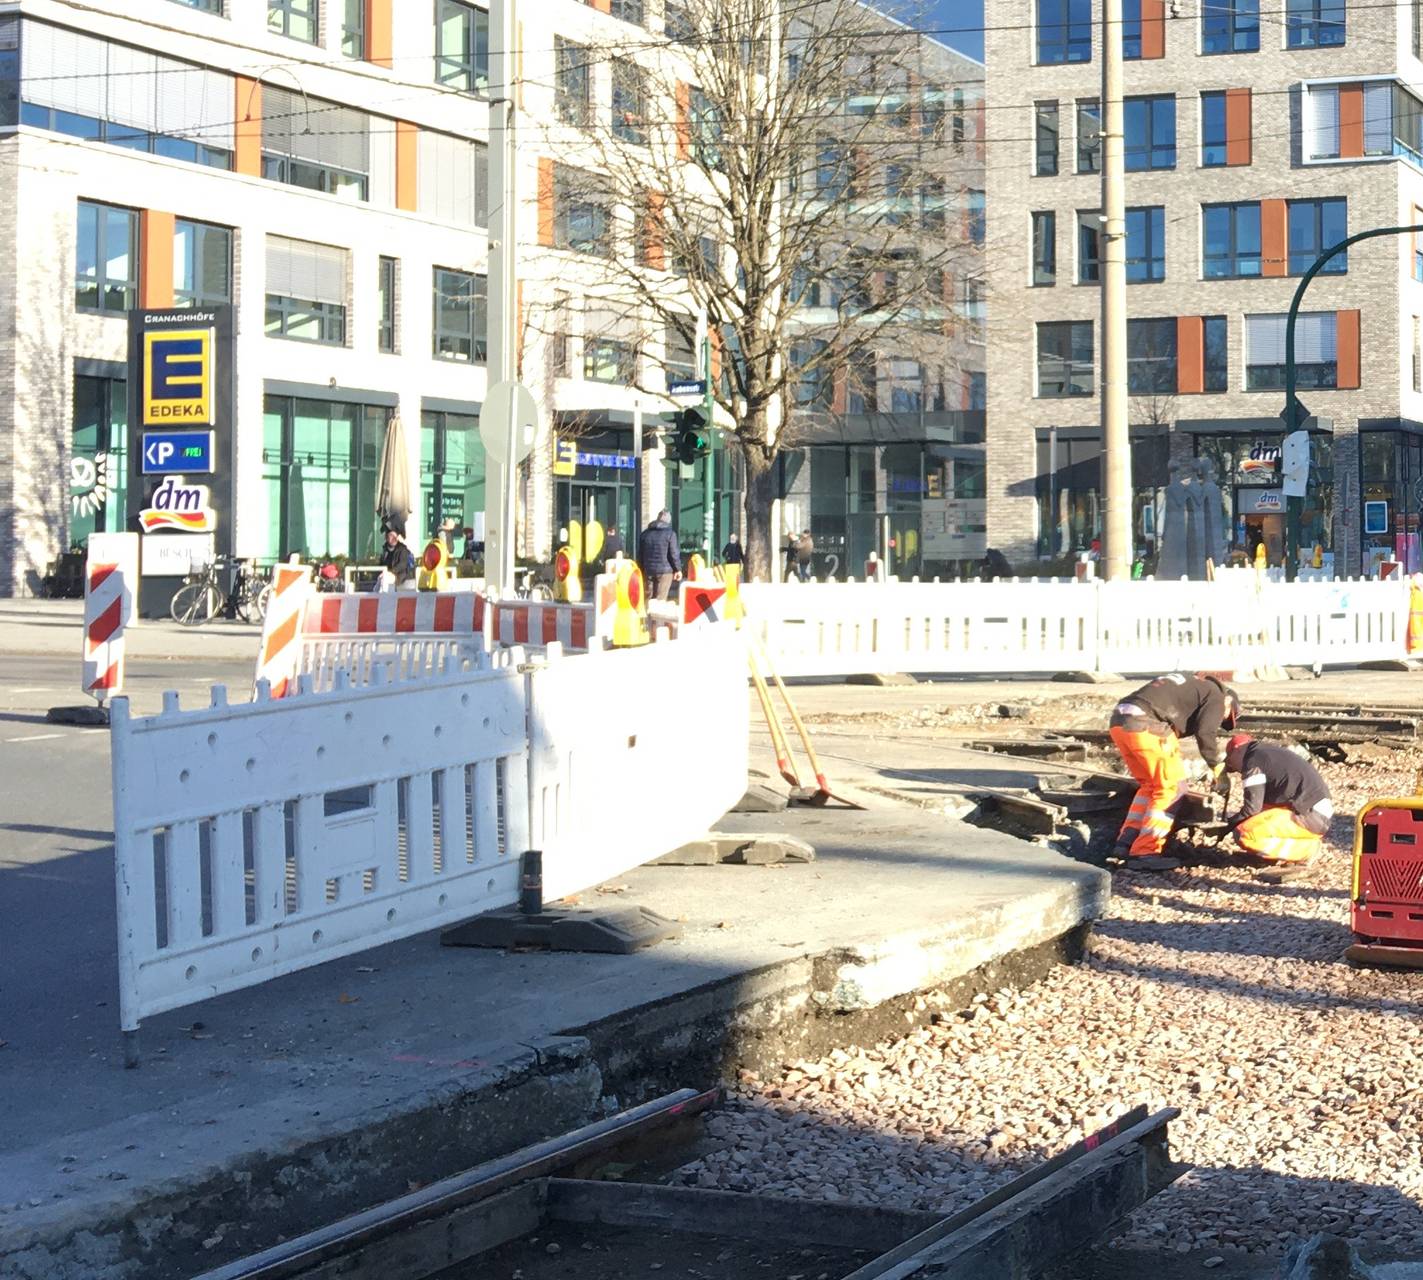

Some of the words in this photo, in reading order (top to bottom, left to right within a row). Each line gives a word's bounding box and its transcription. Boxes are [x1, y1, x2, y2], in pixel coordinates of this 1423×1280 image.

[151, 338, 203, 400] E
[150, 405, 205, 417] EDEKA
[158, 442, 174, 465] P
[1249, 441, 1281, 460] dm
[154, 480, 201, 511] dm
[1260, 491, 1278, 503] dm
